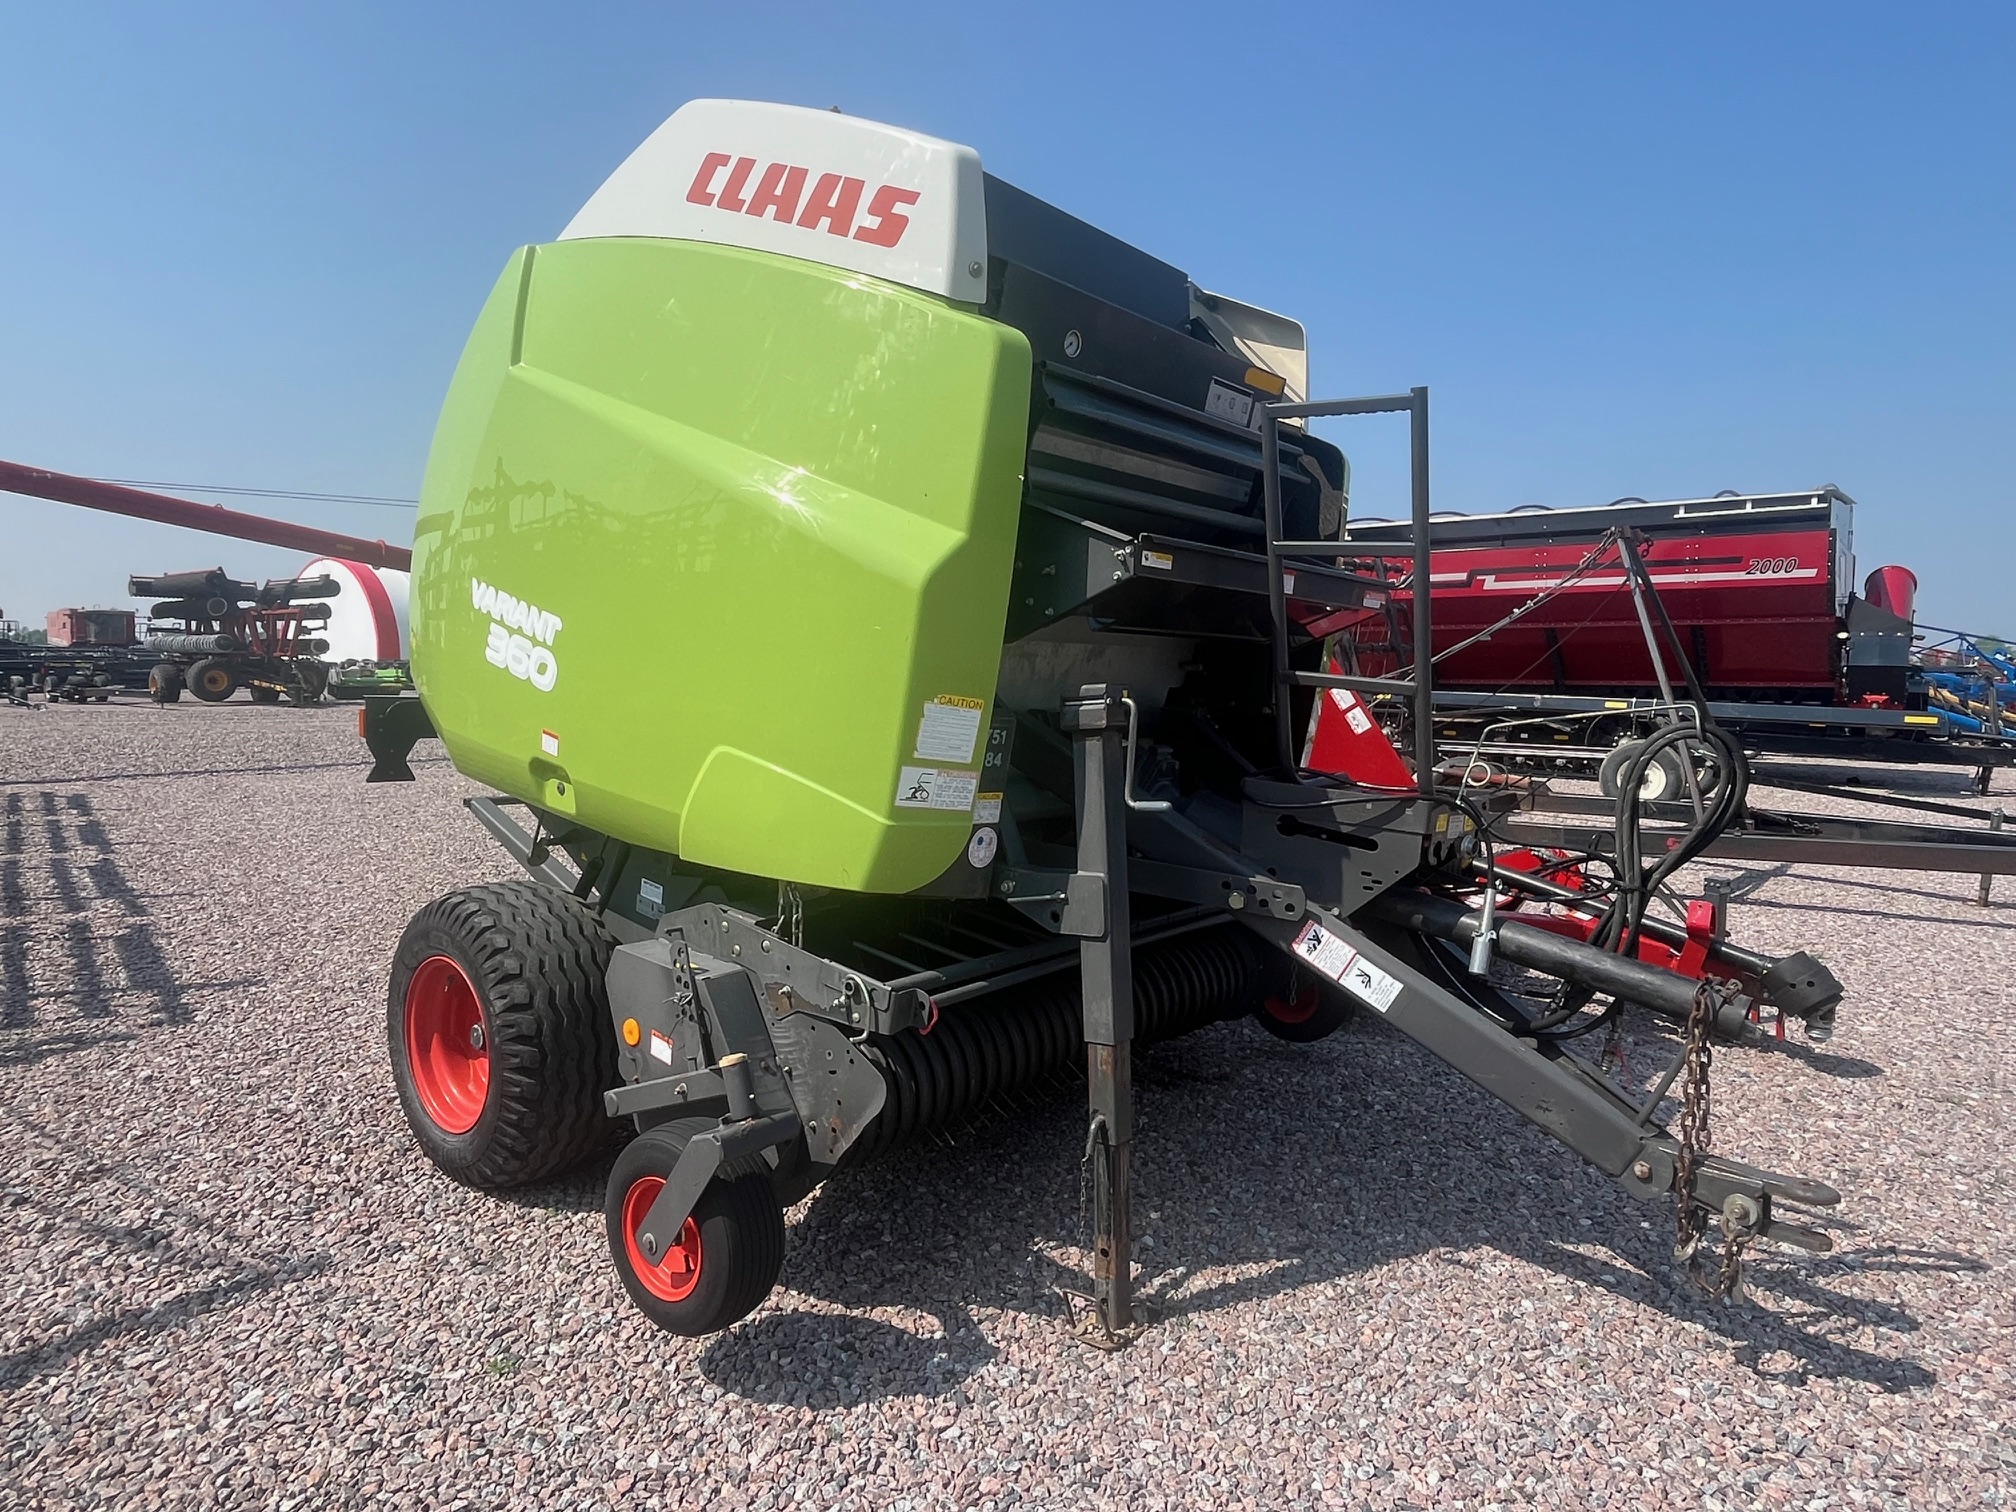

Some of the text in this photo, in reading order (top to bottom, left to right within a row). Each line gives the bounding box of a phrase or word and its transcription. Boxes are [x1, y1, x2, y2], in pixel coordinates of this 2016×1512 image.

[686, 152, 921, 249] CLAAS
[1745, 556, 1799, 575] 2000
[471, 576, 563, 647] VARIANT
[485, 621, 558, 693] 360
[939, 695, 984, 710] CAUTION
[985, 752, 1003, 767] 84
